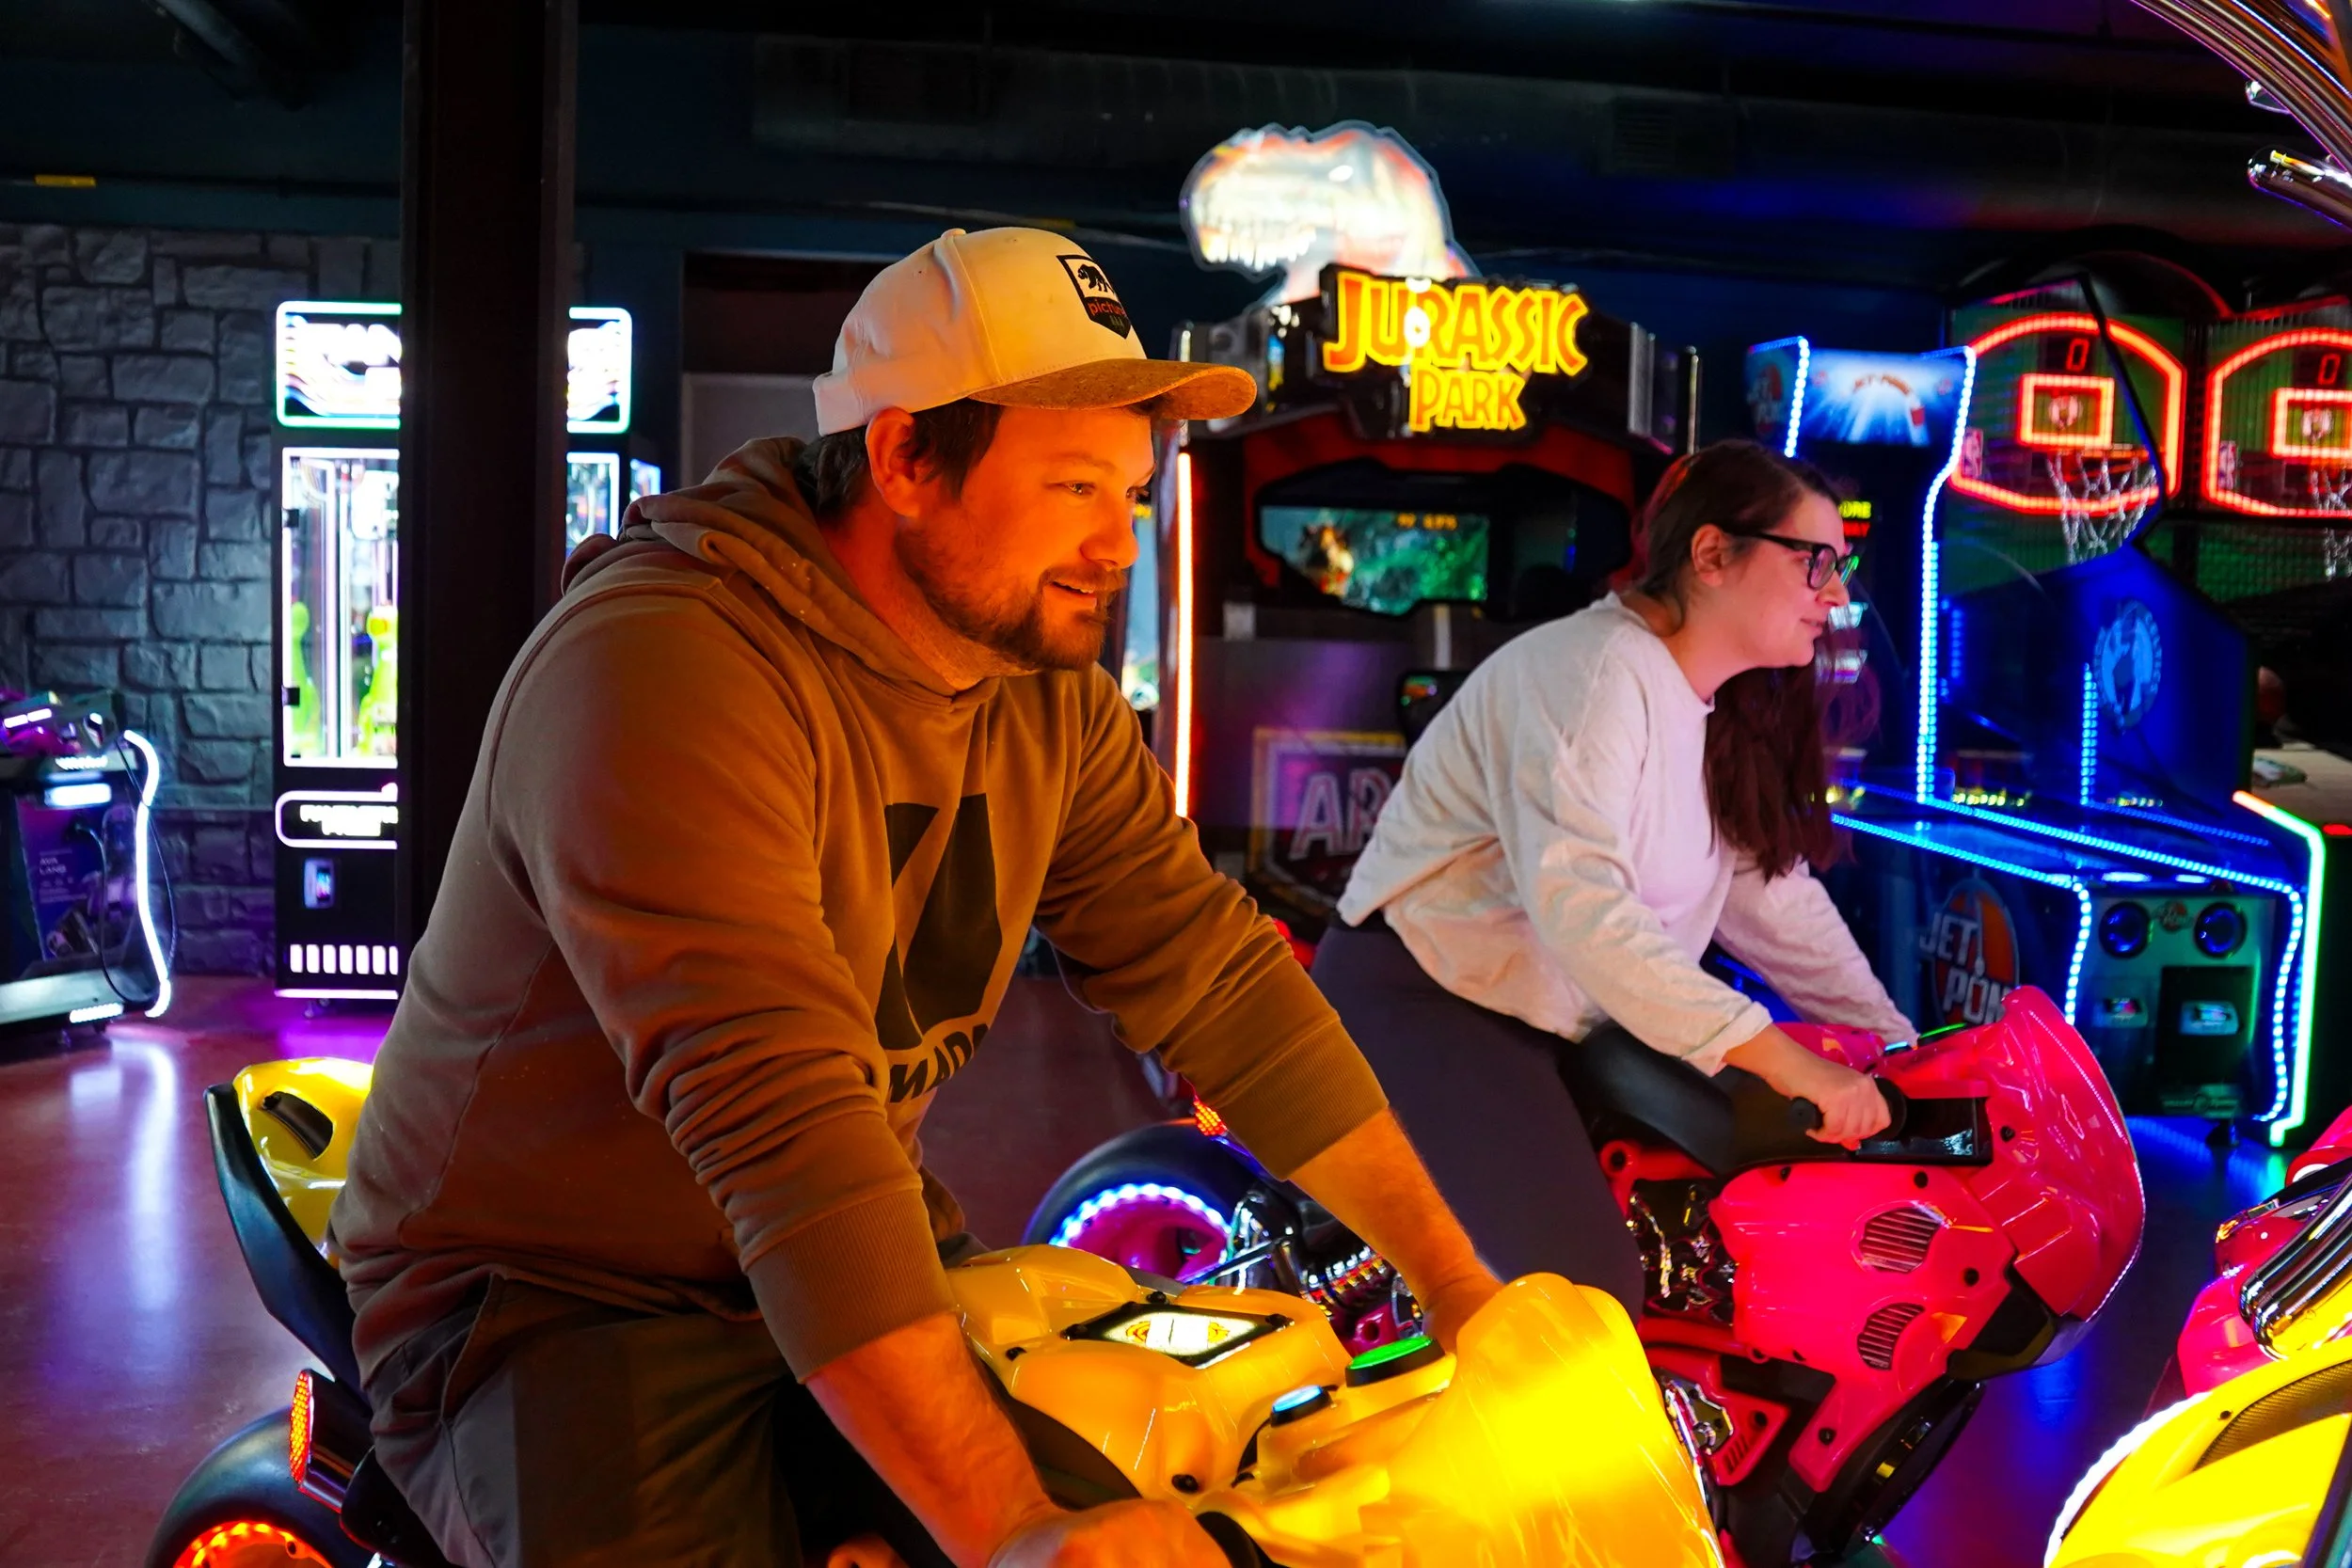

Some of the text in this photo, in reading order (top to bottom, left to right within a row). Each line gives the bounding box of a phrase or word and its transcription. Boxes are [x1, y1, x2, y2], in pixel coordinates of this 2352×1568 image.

[1323, 271, 1589, 376] JURASSIC
[2066, 338, 2090, 372] 0
[2317, 353, 2341, 385] 0
[1408, 367, 1527, 433] PARK
[1918, 911, 1979, 967] JET
